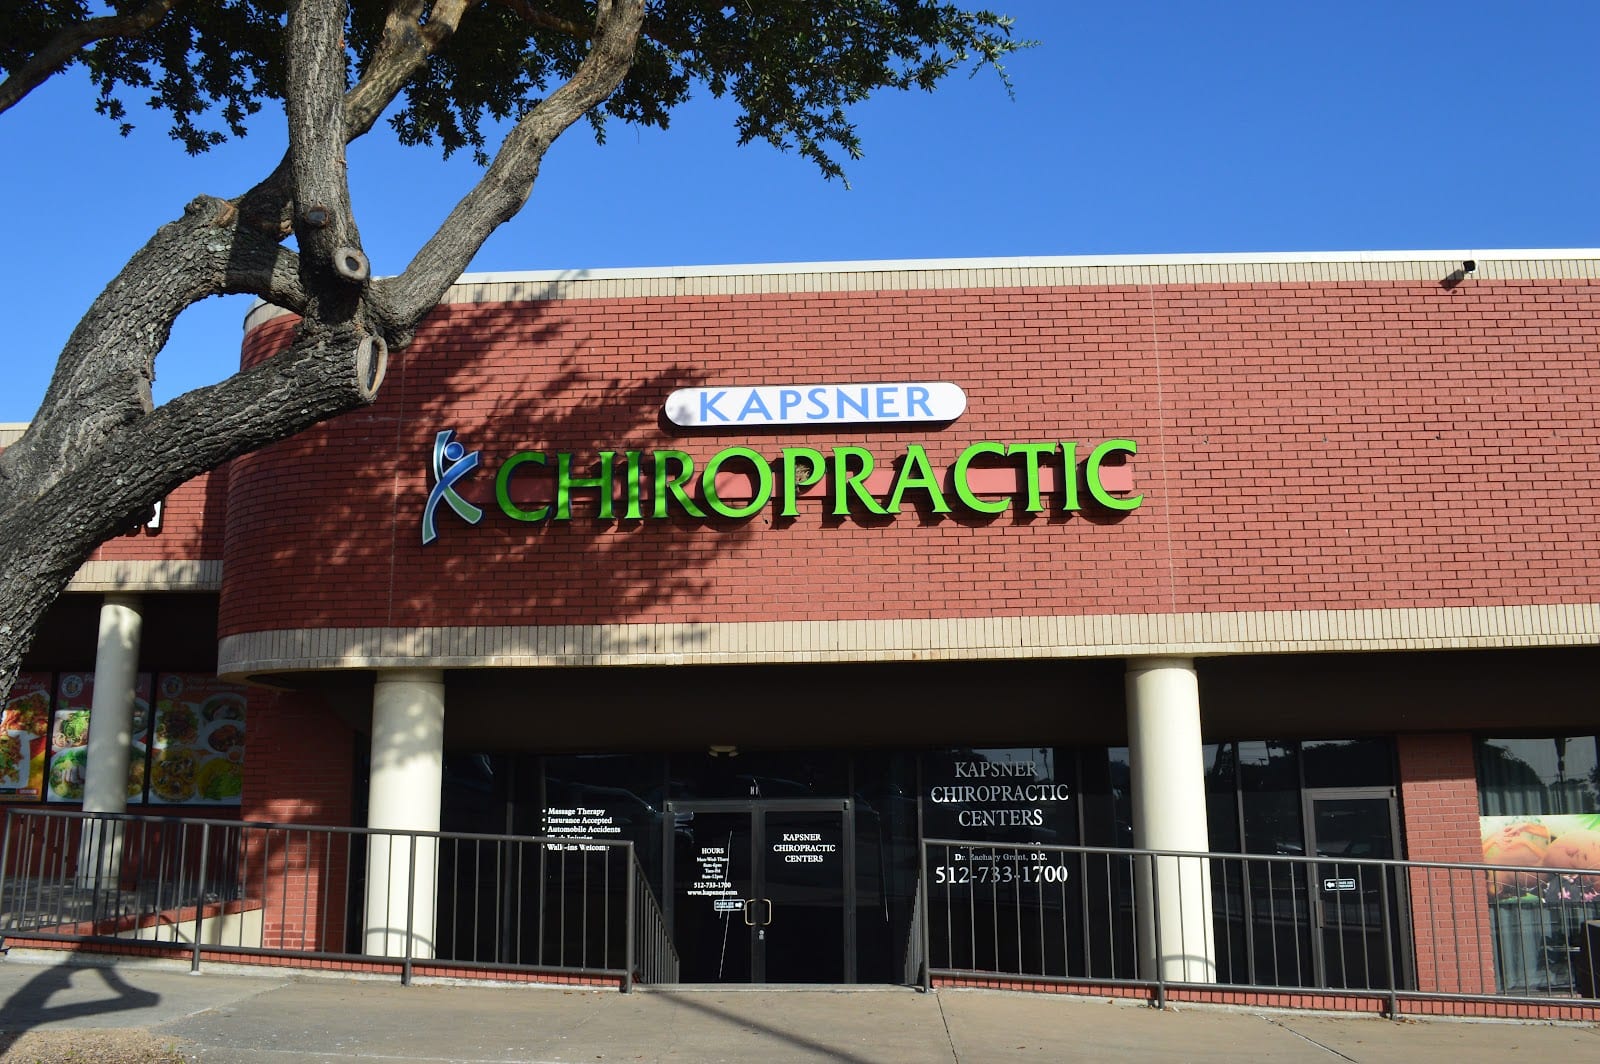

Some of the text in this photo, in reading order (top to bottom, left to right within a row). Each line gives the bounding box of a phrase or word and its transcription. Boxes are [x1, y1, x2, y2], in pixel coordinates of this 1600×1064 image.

[700, 386, 934, 422] KAPSNER
[495, 438, 1144, 522] CHIROPRACTIC
[954, 761, 1038, 778] KAPSNER
[931, 784, 1069, 803] CHIROPRACTIC
[547, 808, 605, 816] Massage Therapy
[959, 809, 1043, 827] CENTERS
[581, 817, 612, 825] Accepted
[783, 833, 821, 841] KAPSNER
[773, 844, 836, 852] CHIROPRACTIC
[785, 855, 823, 863] CENTERS
[1031, 853, 1048, 861] D.C.
[935, 865, 1068, 884] 512-733-1700
